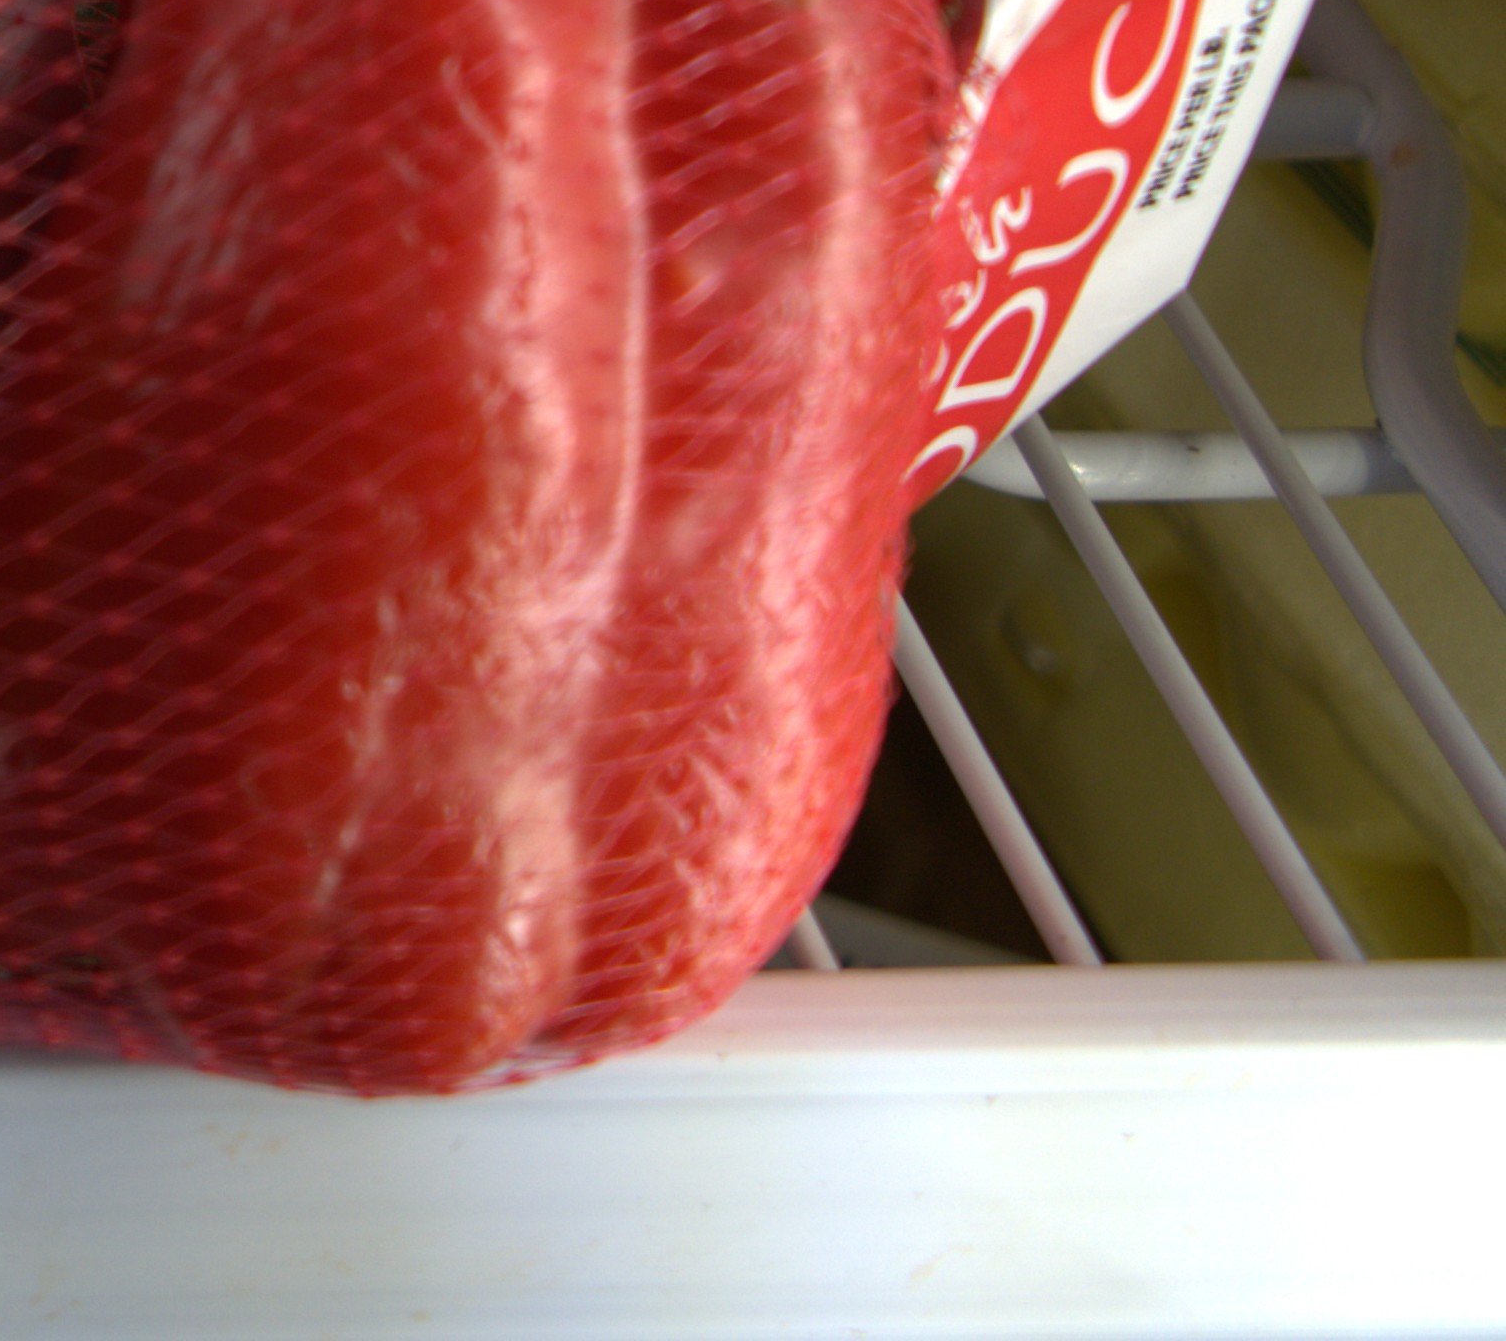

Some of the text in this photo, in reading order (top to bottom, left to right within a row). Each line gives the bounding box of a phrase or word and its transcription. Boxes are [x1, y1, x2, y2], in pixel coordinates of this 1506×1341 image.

[1136, 131, 1192, 210] PRICE
[1175, 77, 1216, 132] PER
[1171, 123, 1226, 200] PRICE
